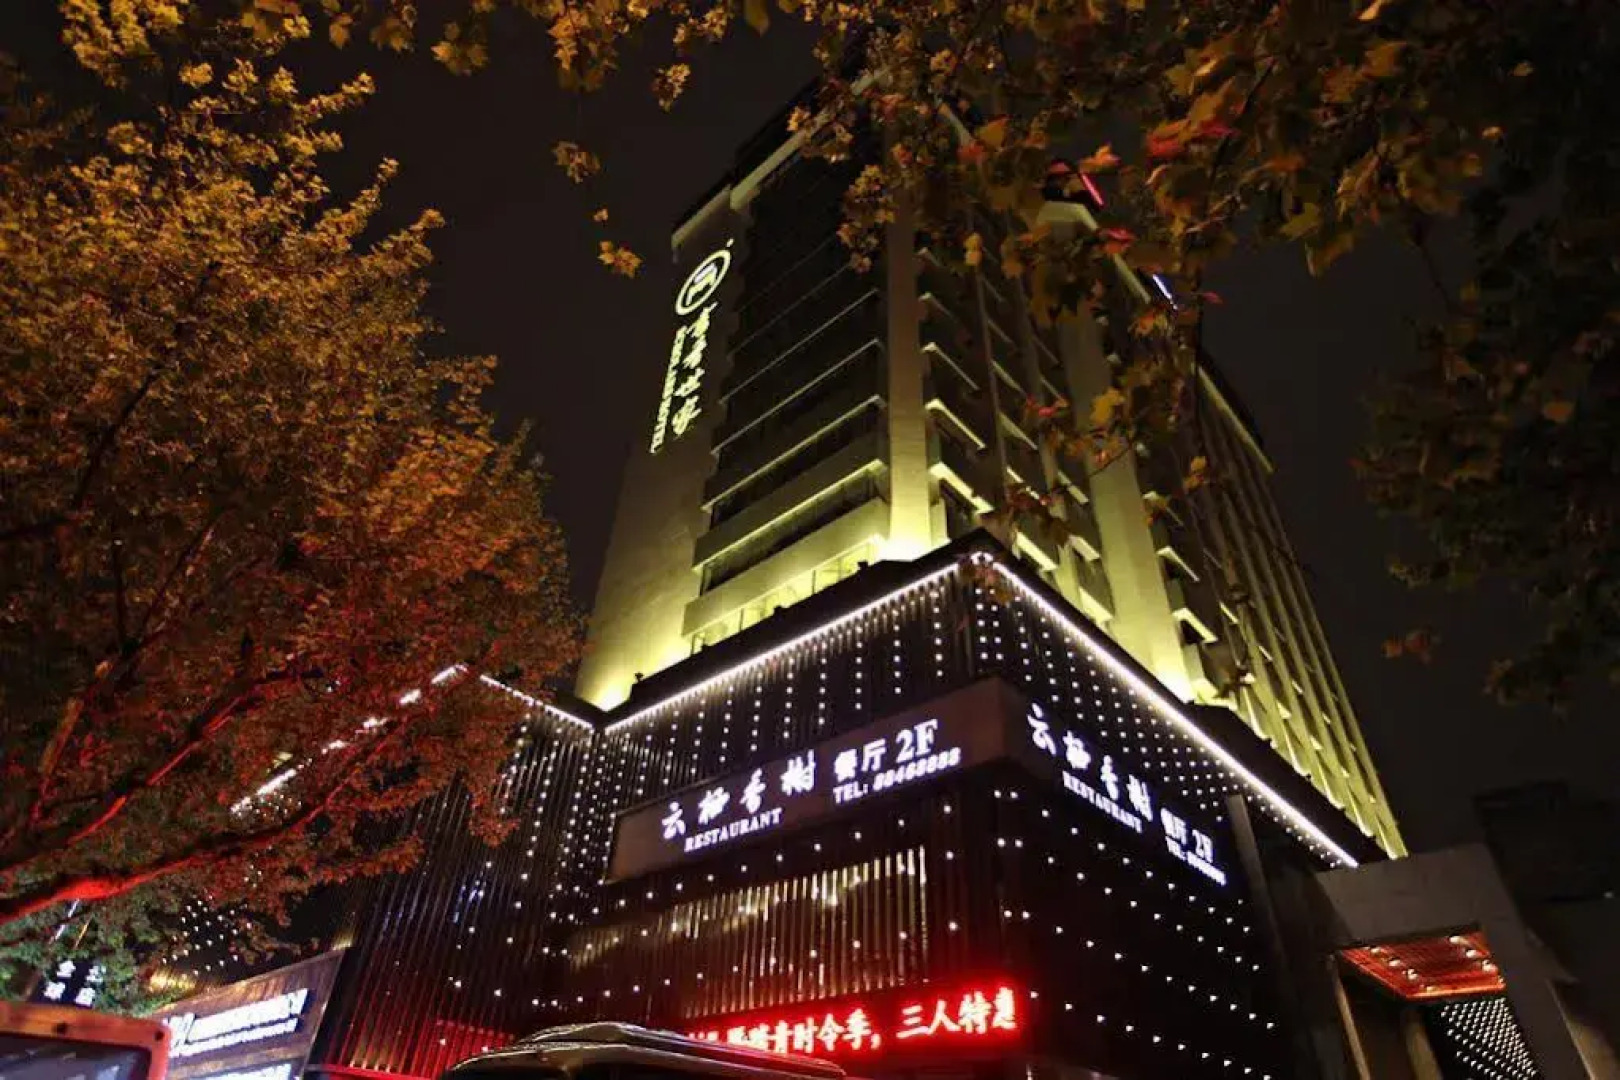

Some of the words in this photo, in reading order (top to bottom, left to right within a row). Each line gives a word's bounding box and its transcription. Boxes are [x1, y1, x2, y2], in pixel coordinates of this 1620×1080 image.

[834, 739, 886, 781] 餐厅
[896, 719, 938, 762] 2F
[684, 808, 782, 852] RESTAURANT
